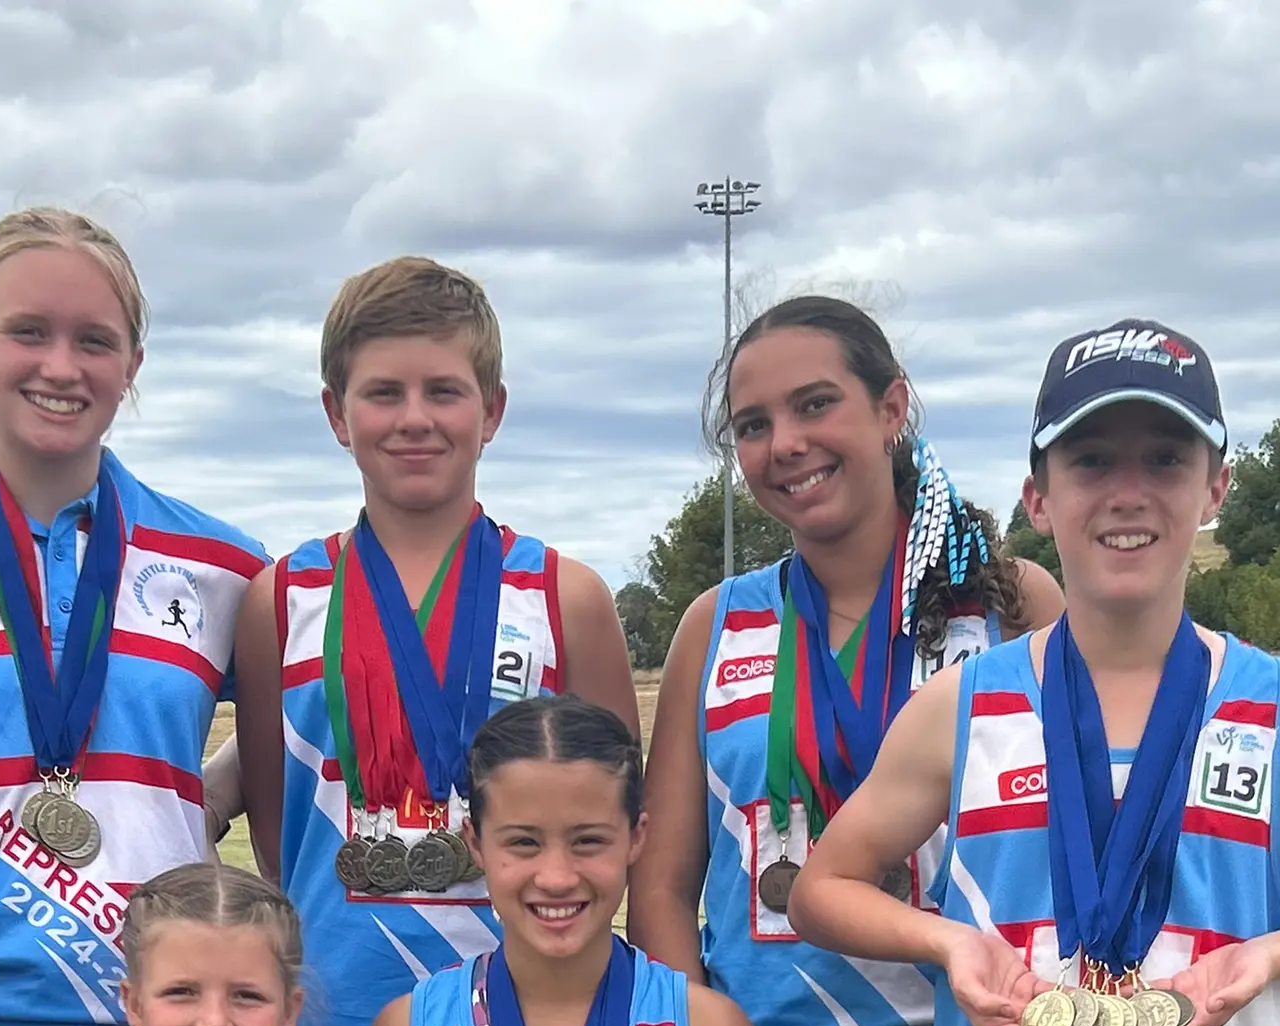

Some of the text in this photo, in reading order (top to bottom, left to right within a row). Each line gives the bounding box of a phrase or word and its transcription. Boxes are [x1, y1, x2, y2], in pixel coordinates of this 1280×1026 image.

[137, 563, 167, 583] LITTLE
[492, 650, 523, 685] 2
[723, 659, 775, 681] coles
[1011, 768, 1047, 795] col
[1210, 763, 1258, 802] 13
[1, 882, 128, 1013] 2024-2
